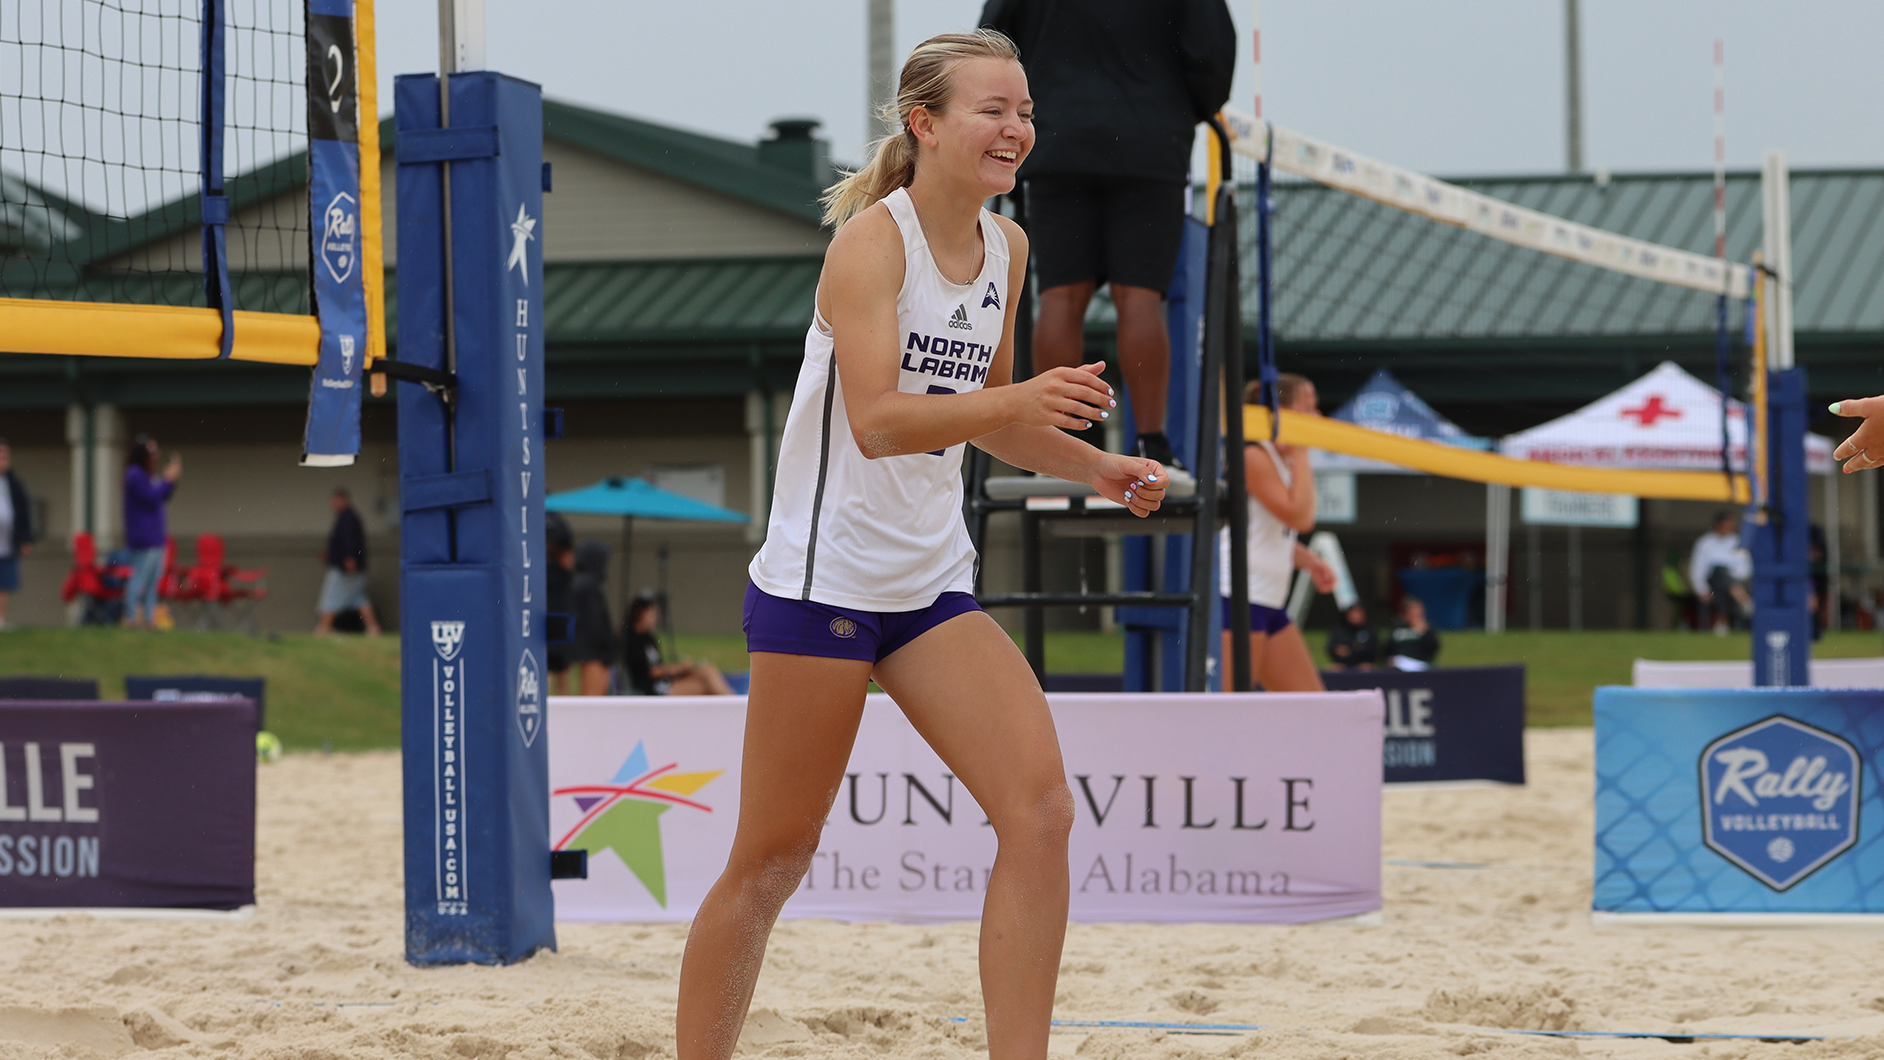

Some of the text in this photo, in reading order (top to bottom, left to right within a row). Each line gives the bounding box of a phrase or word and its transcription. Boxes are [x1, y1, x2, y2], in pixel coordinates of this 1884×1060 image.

[906, 332, 993, 363] NORTH
[948, 319, 973, 331] adidas
[901, 353, 988, 384] LABAM
[515, 299, 531, 637] HUNTSVILLE
[1385, 690, 1436, 737] LE
[825, 772, 1316, 832] UNVILLE
[1714, 747, 1850, 811] Rally
[1720, 814, 1842, 832] VOLLEYBALL
[805, 850, 880, 891] The
[1079, 853, 1293, 896] Alabama
